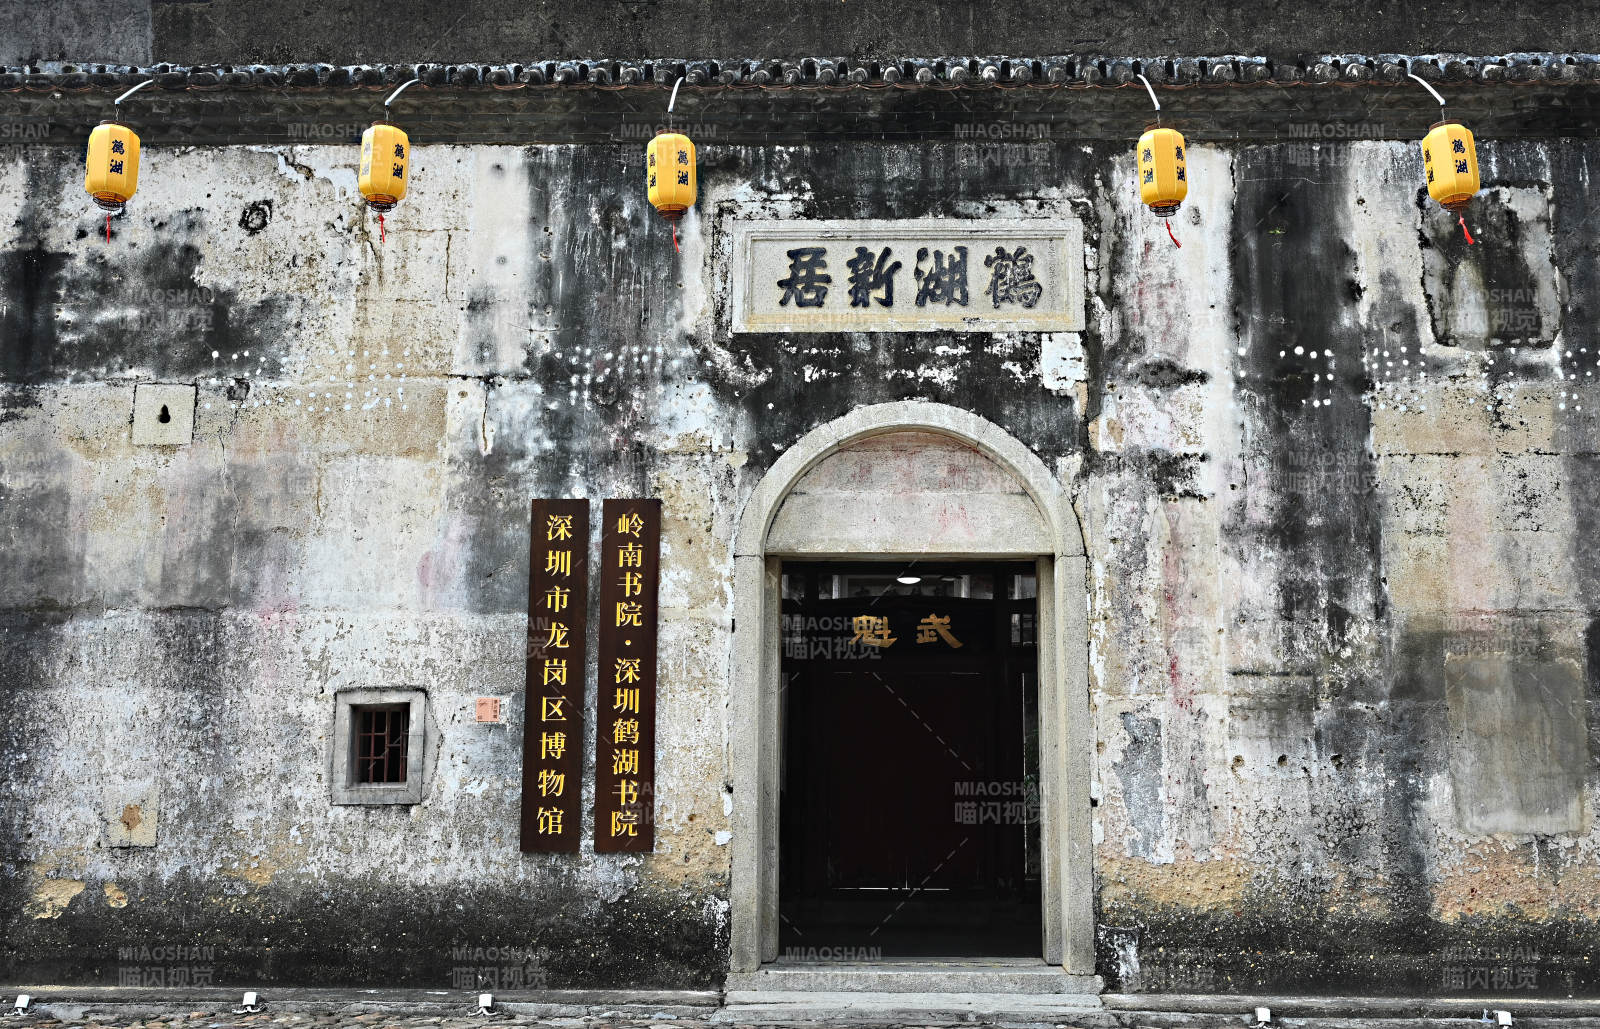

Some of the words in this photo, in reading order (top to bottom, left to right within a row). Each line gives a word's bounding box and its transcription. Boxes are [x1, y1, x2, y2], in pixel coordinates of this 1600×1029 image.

[776, 245, 1043, 309] 鶴湖新居
[536, 514, 573, 835] 深圳市龙岗区博物馆
[611, 512, 645, 837] 岭南书院·深圳鹤湖书院
